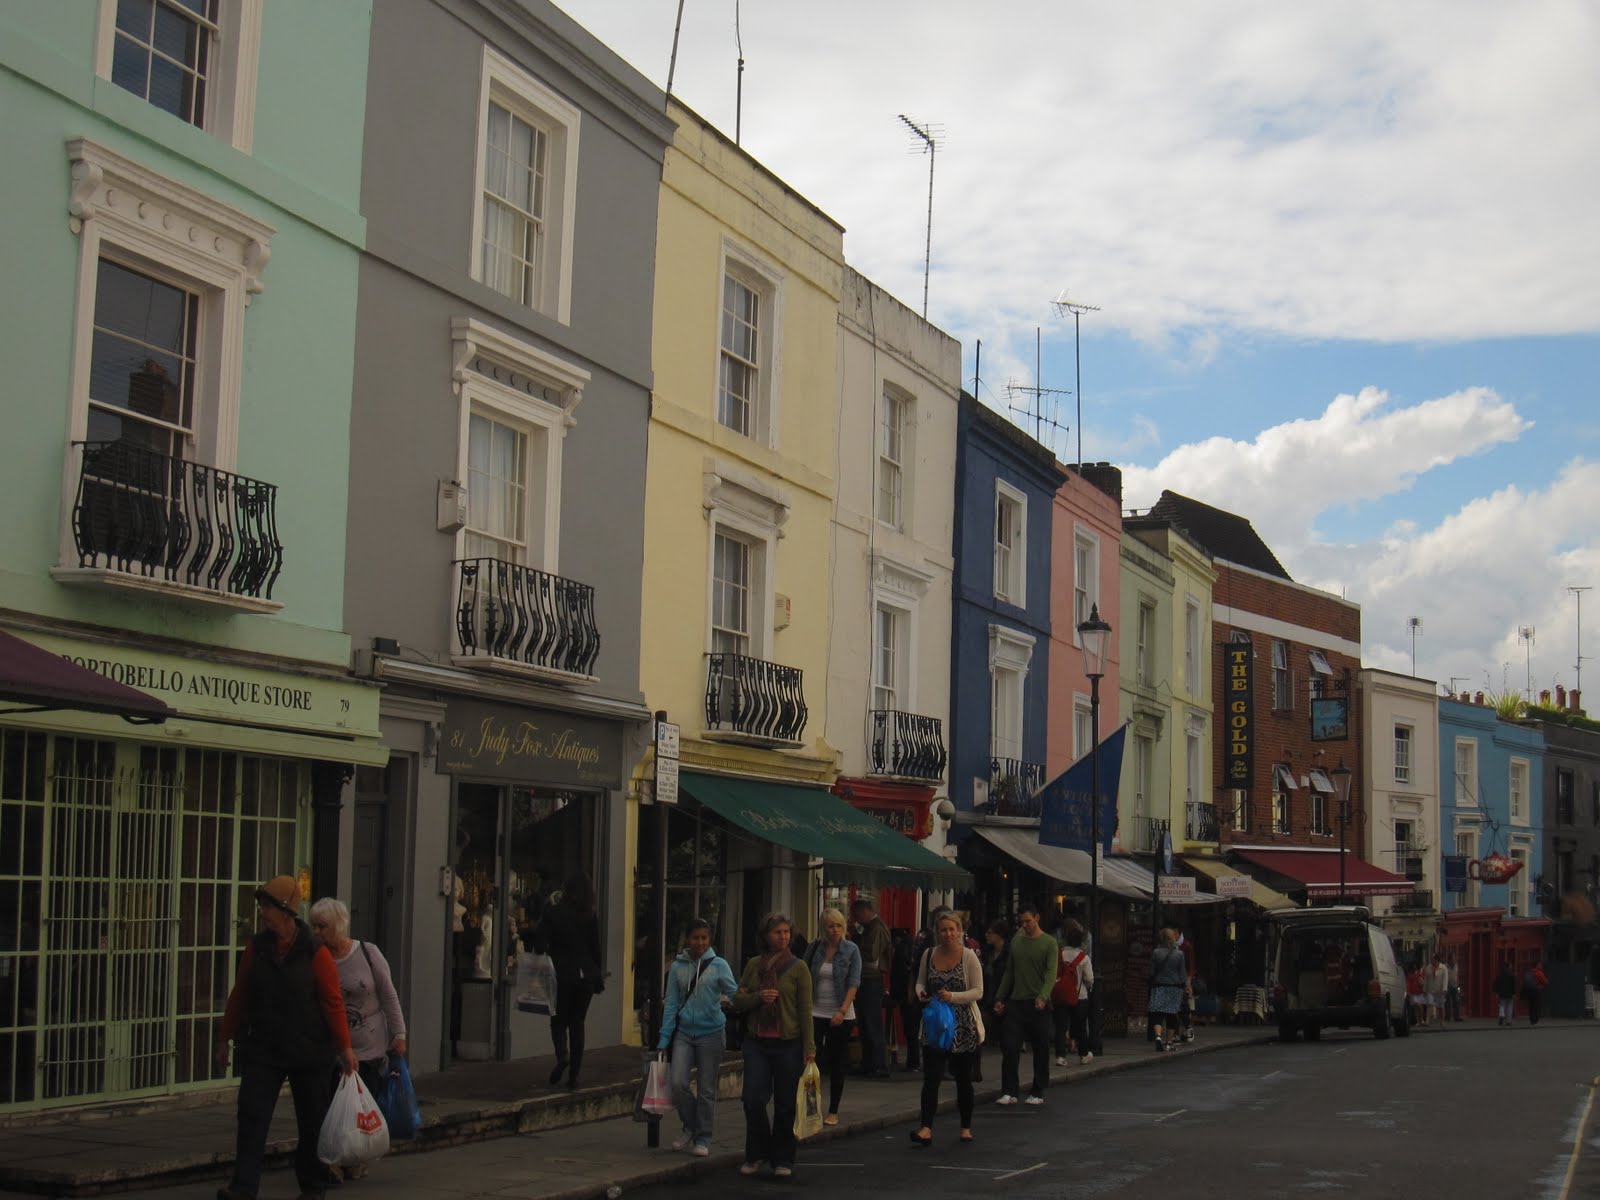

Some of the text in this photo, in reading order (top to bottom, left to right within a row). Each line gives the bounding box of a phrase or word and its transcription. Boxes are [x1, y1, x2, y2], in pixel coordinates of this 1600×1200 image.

[61, 655, 312, 711] RTOBELLO ANTIQUE STORE
[1231, 651, 1248, 691] THE
[340, 699, 350, 713] 79
[1231, 701, 1248, 755] GOLD
[470, 716, 509, 765] Judy
[512, 721, 543, 755] Fox
[545, 729, 600, 769] Antiques
